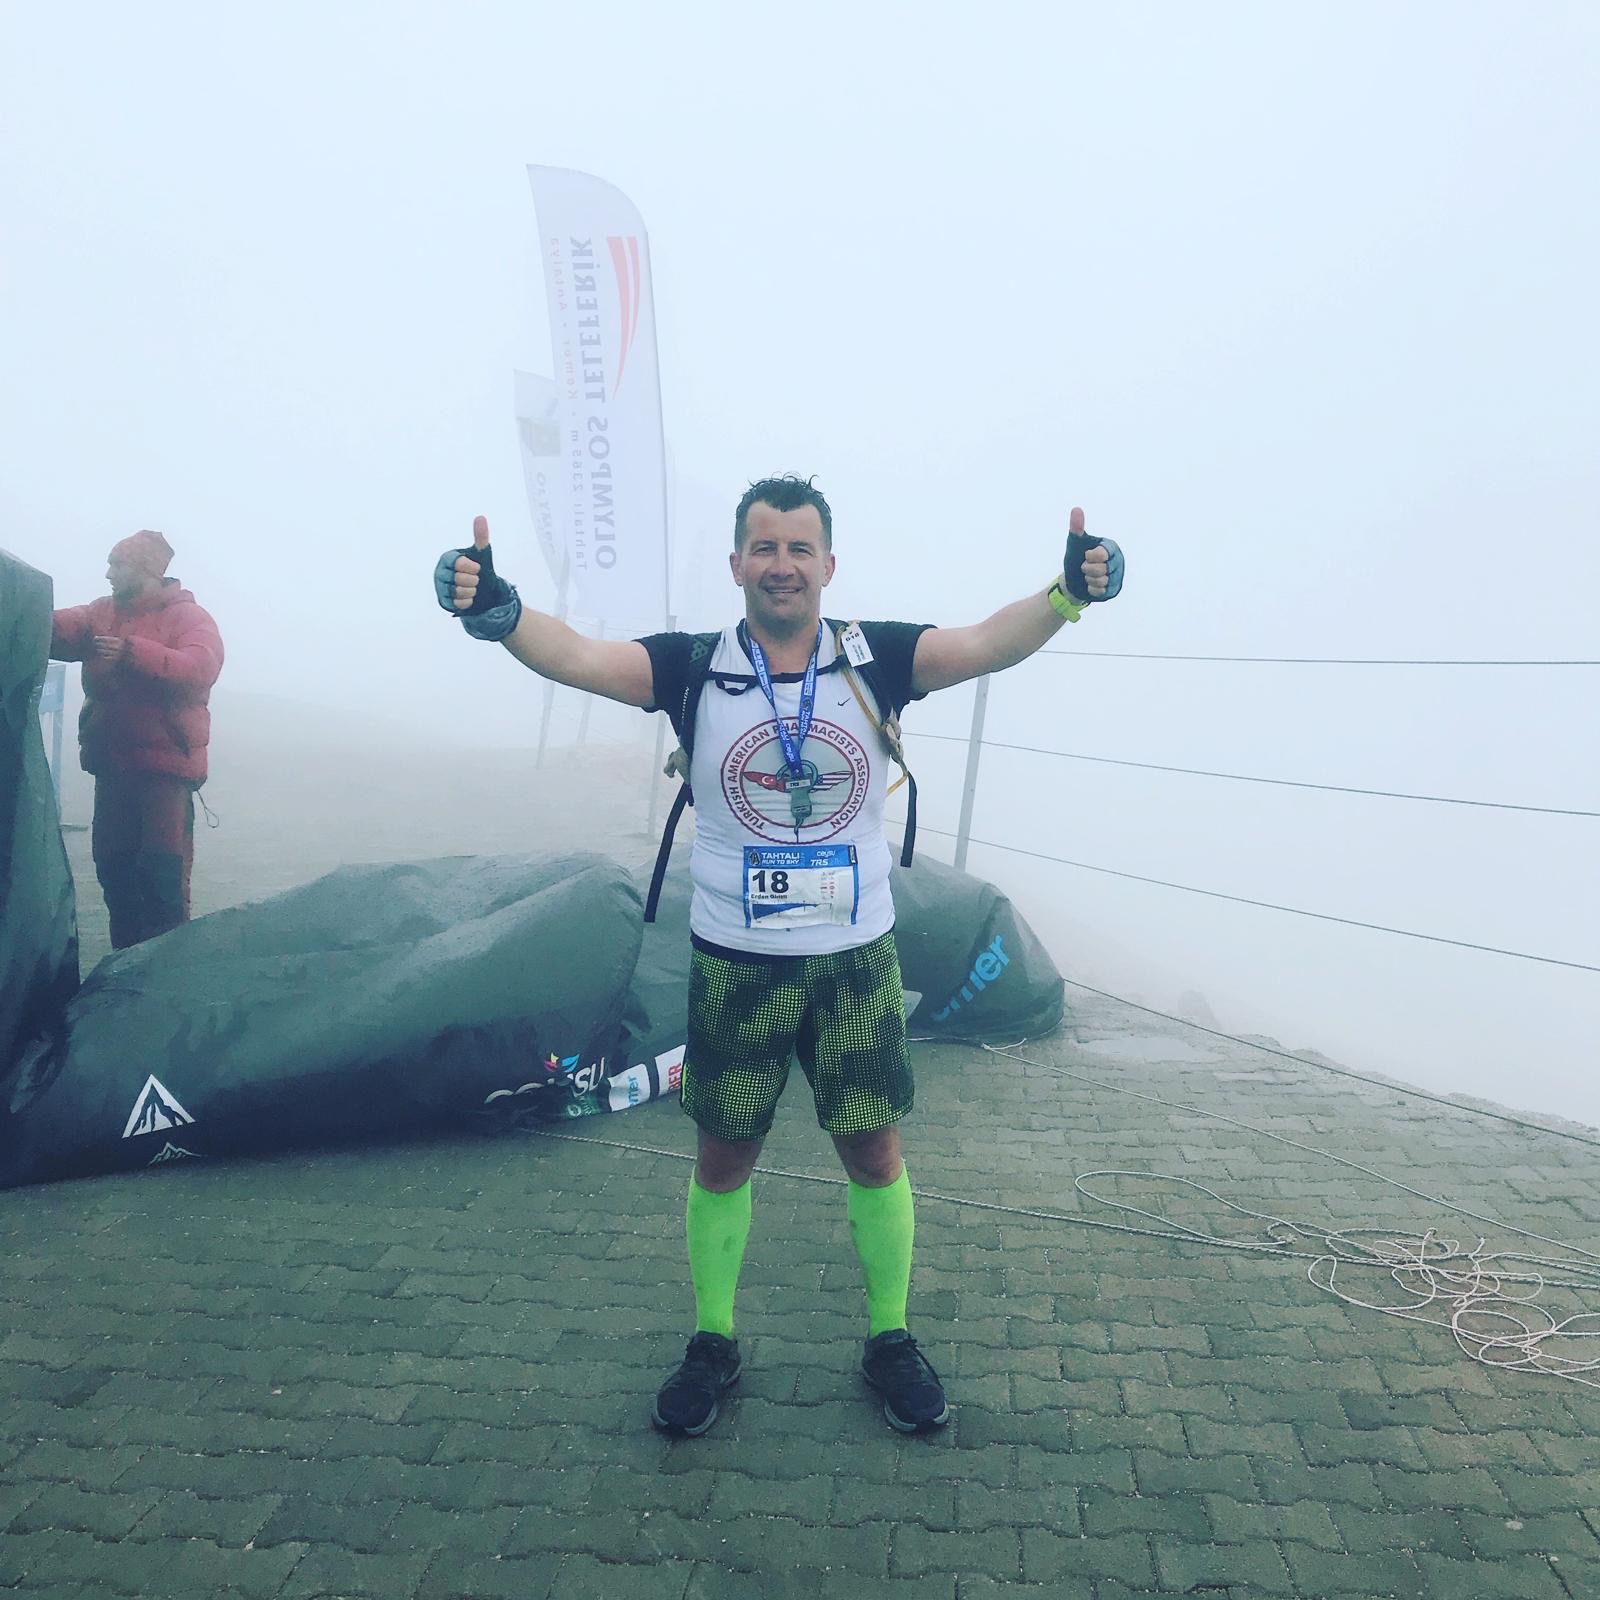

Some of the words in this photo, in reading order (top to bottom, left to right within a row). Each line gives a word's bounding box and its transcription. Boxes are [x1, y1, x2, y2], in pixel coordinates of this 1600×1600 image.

[727, 728, 769, 783] AMERICAN
[772, 722, 858, 756] PHAMACISTS
[729, 785, 765, 830] TURKISH
[830, 757, 866, 830] ASSOCIATION
[752, 870, 789, 893] 18
